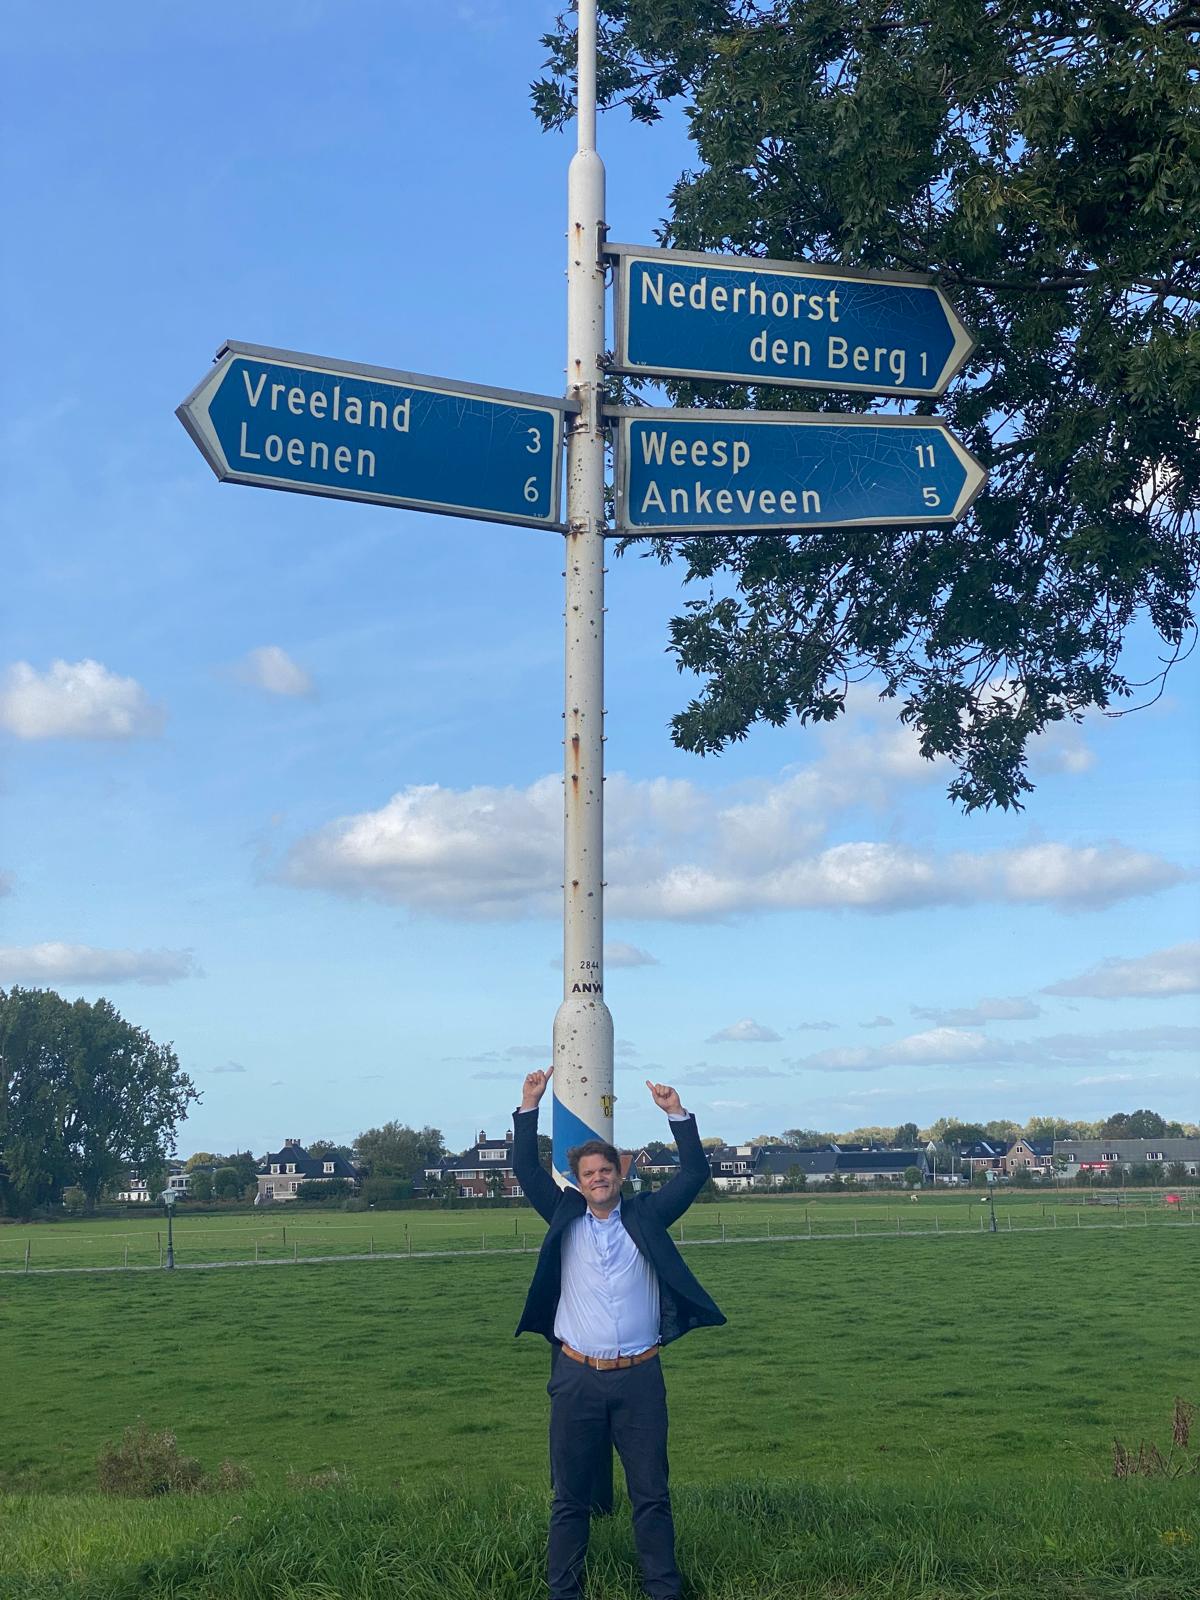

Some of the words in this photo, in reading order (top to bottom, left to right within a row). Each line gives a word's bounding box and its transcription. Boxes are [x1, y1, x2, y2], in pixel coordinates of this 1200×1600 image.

[641, 271, 840, 323] Nederhorst
[750, 330, 811, 366] den
[828, 336, 906, 385] Berg
[919, 351, 928, 377] 1
[242, 369, 411, 433] Vreeland
[239, 421, 377, 478] Loenen
[526, 427, 541, 454] 3
[641, 431, 750, 474] Weesp
[915, 444, 936, 468] 11
[523, 476, 539, 502] 6
[641, 481, 821, 514] Ankeveen
[922, 487, 941, 507] 5
[580, 960, 599, 969] 2844
